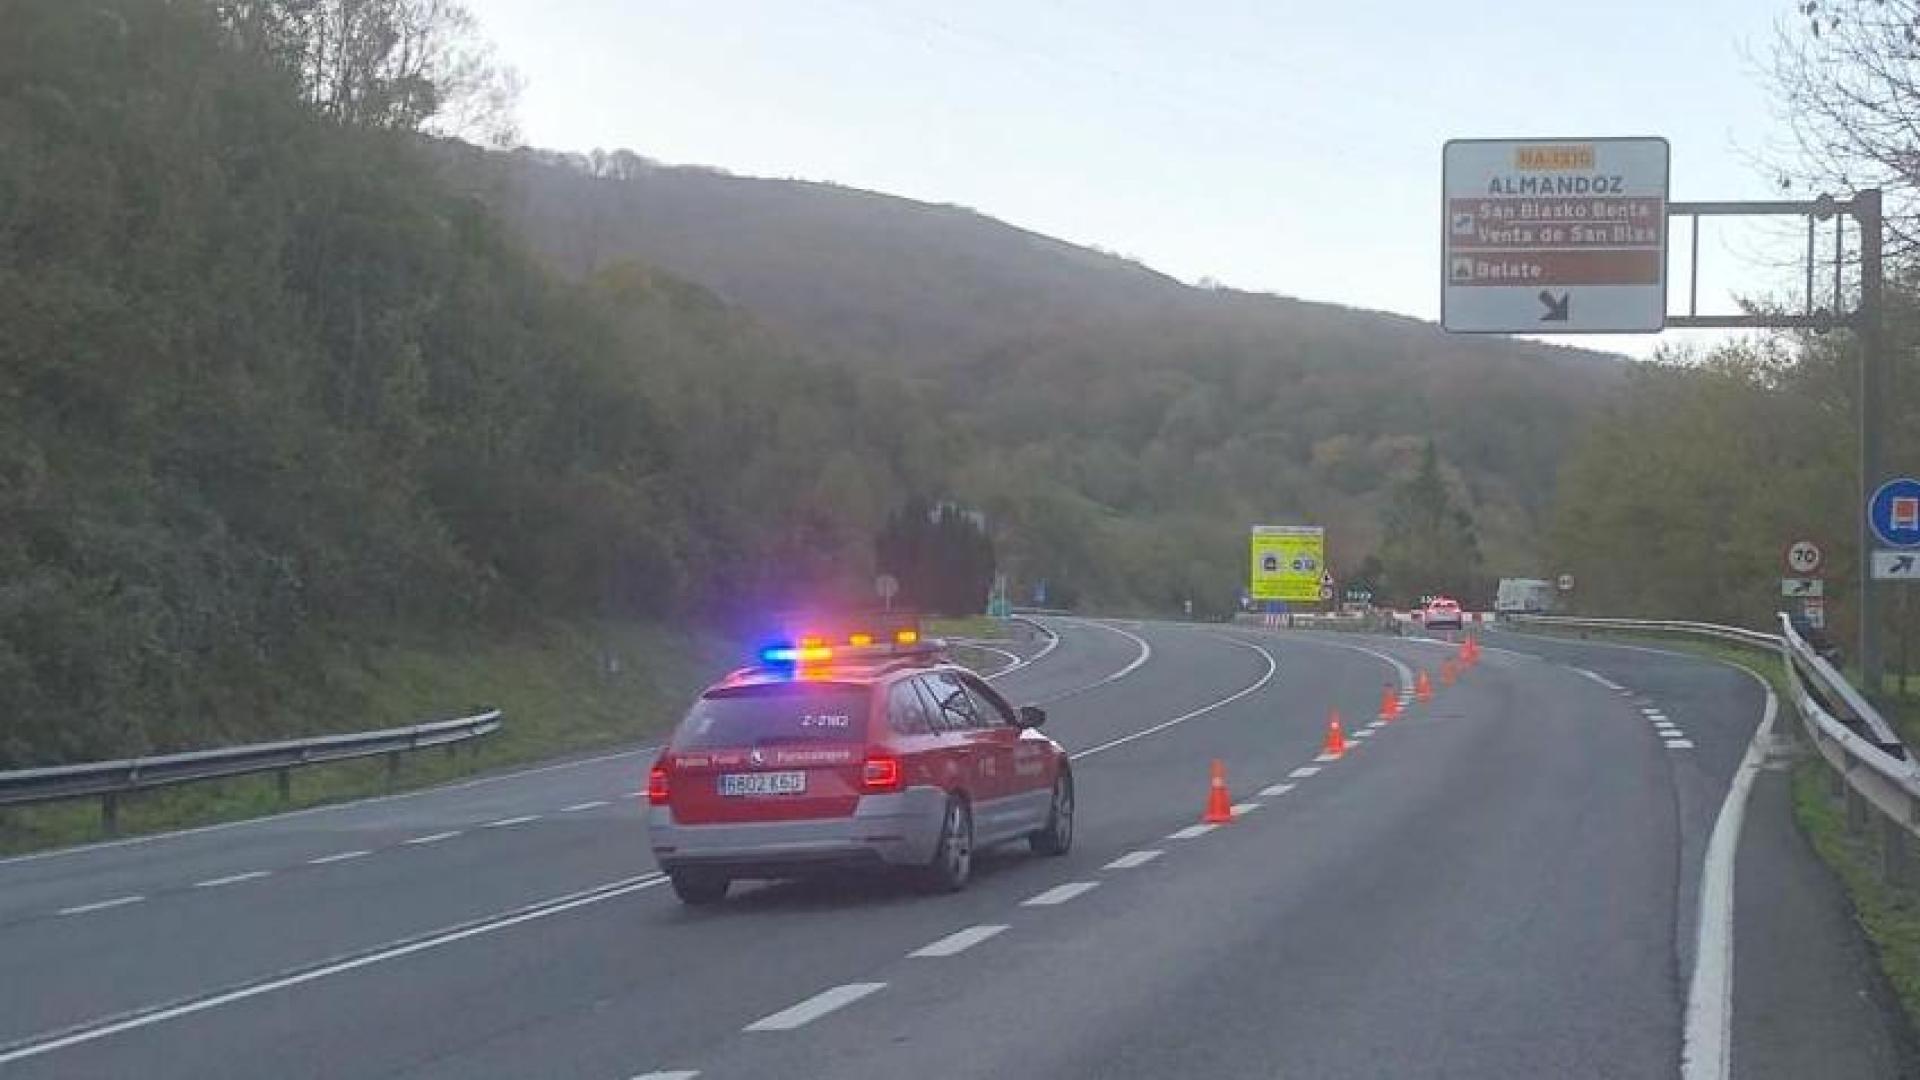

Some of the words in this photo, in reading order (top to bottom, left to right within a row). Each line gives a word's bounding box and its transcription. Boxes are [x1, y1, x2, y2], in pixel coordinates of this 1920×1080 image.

[1488, 175, 1624, 194] ALMANDOZ
[1479, 202, 1514, 217] San
[1521, 202, 1586, 217] Blasko
[1477, 225, 1532, 242] Venta
[1539, 225, 1564, 241] de
[1570, 225, 1607, 241] San
[1613, 225, 1656, 241] Blas
[1793, 550, 1817, 563] 70
